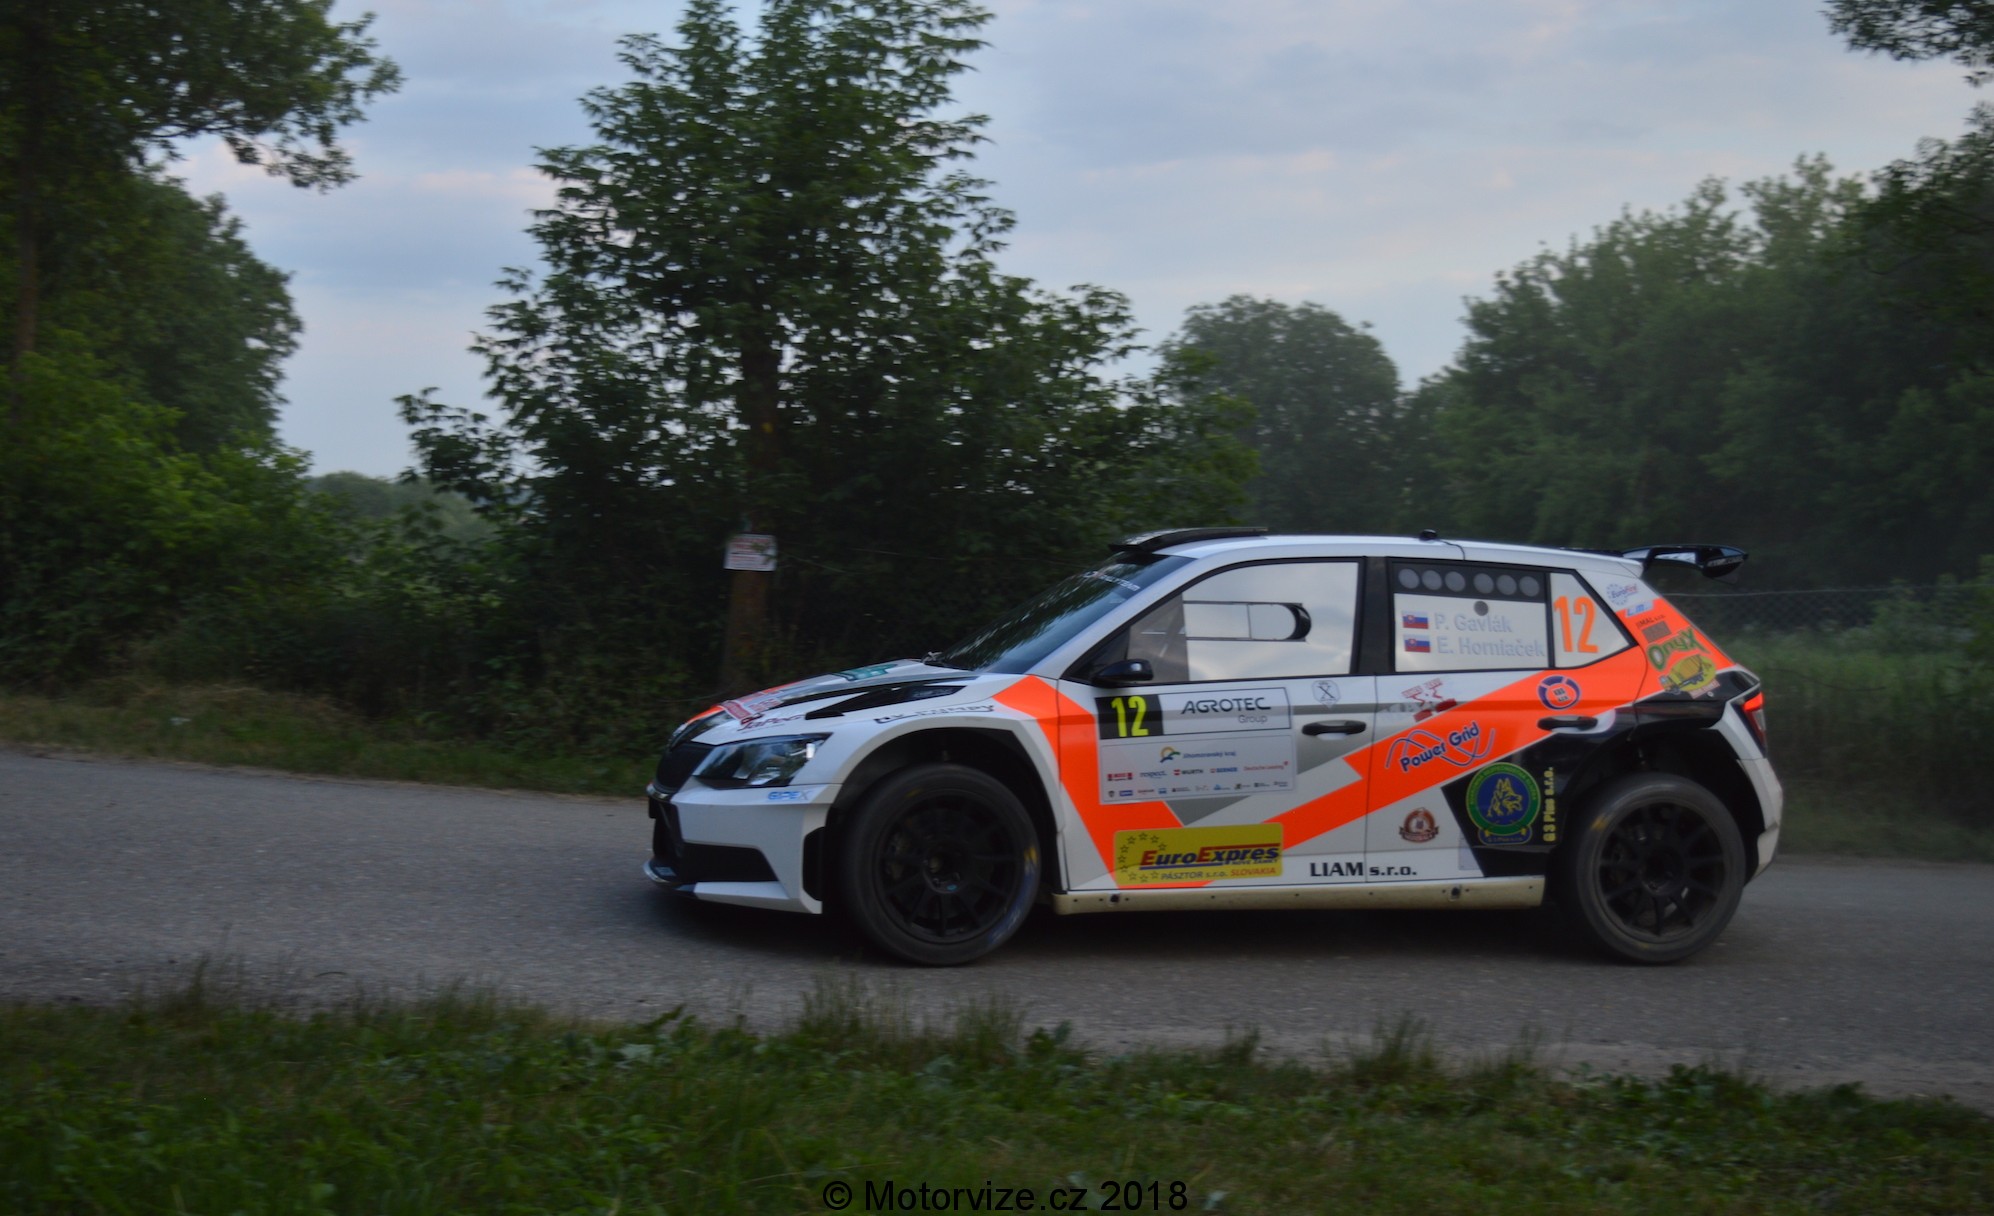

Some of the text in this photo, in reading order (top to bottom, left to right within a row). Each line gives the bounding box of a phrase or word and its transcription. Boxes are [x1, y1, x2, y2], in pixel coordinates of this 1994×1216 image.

[1433, 612, 1513, 633] P. Gavlák
[1553, 596, 1599, 653] 12
[1436, 636, 1546, 657] E. Horniaček
[1111, 695, 1149, 738] 12
[1181, 697, 1272, 715] AGROTEC
[1238, 714, 1268, 725] Group
[1400, 721, 1480, 773] Power Grid
[1140, 844, 1280, 867] EuroExpres
[1160, 870, 1203, 880] PÁSZTOR
[1230, 867, 1277, 877] SLOVAKIA
[1310, 862, 1418, 877] LIAM s.r.o.
